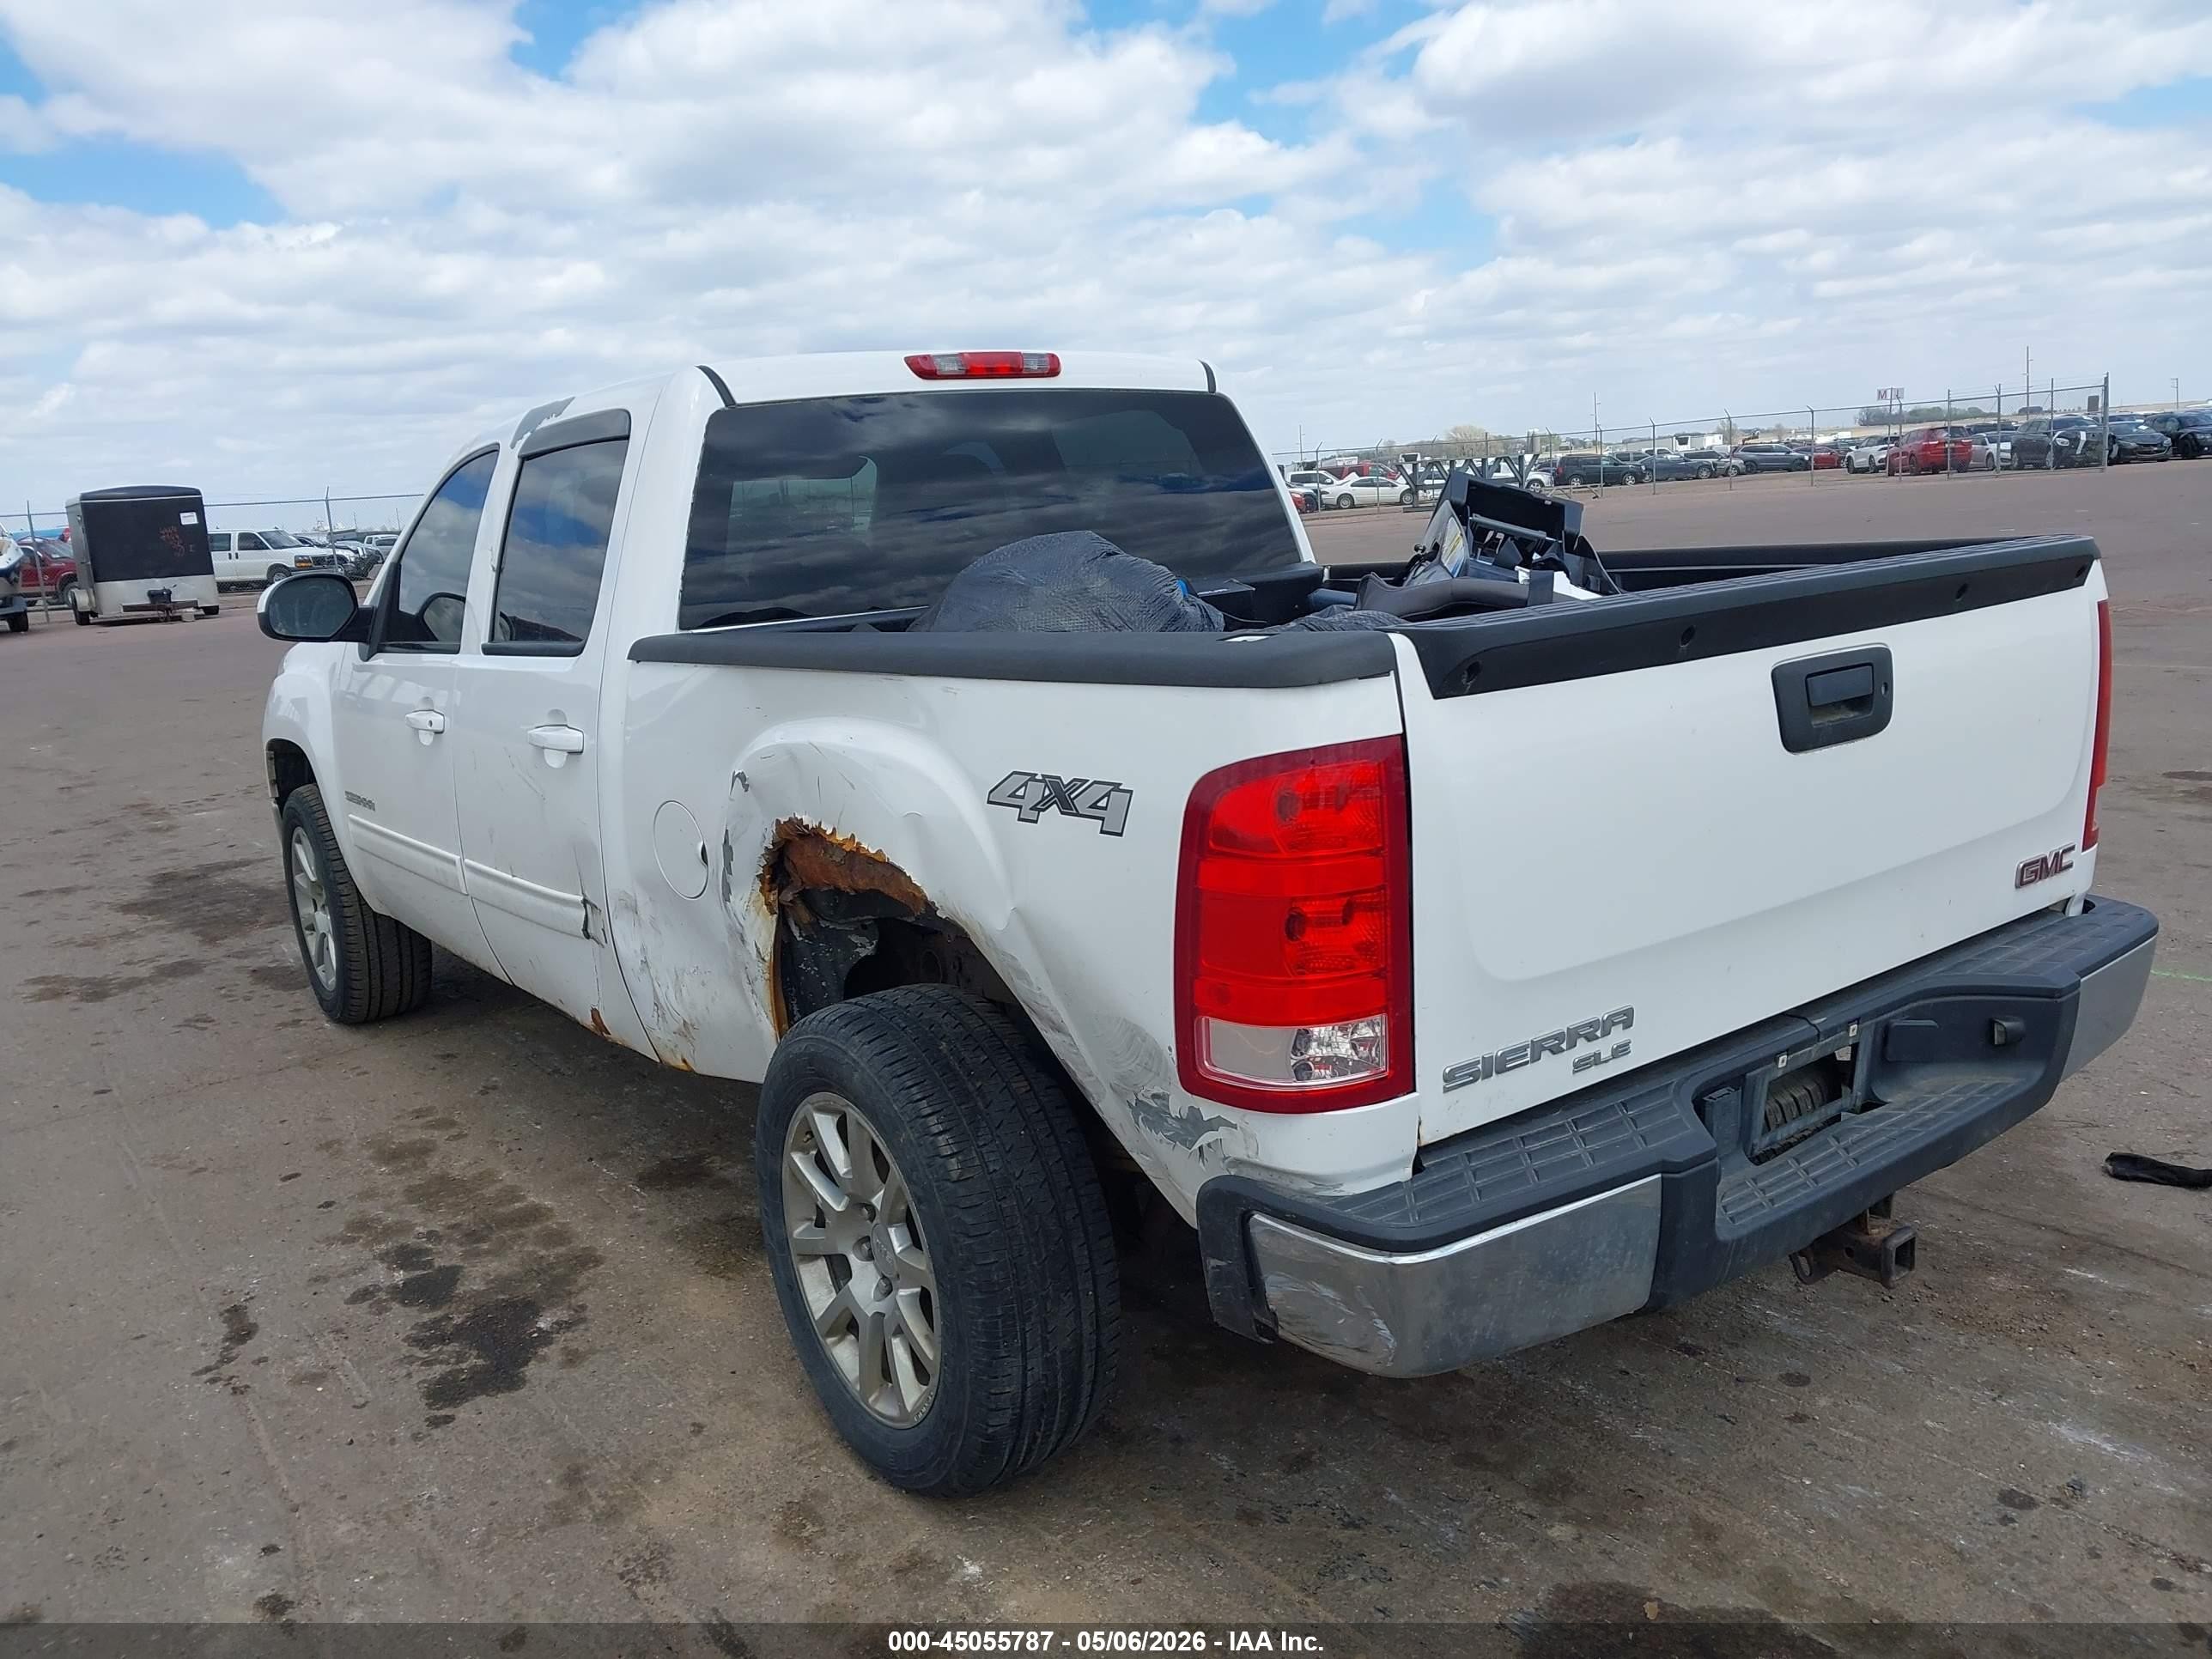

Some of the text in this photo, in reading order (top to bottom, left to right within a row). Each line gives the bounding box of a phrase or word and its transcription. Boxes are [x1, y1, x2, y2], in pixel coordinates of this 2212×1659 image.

[2014, 842, 2076, 889] GMC
[1443, 1004, 1636, 1094] SIERRA
[1572, 1038, 1632, 1075] SLE
